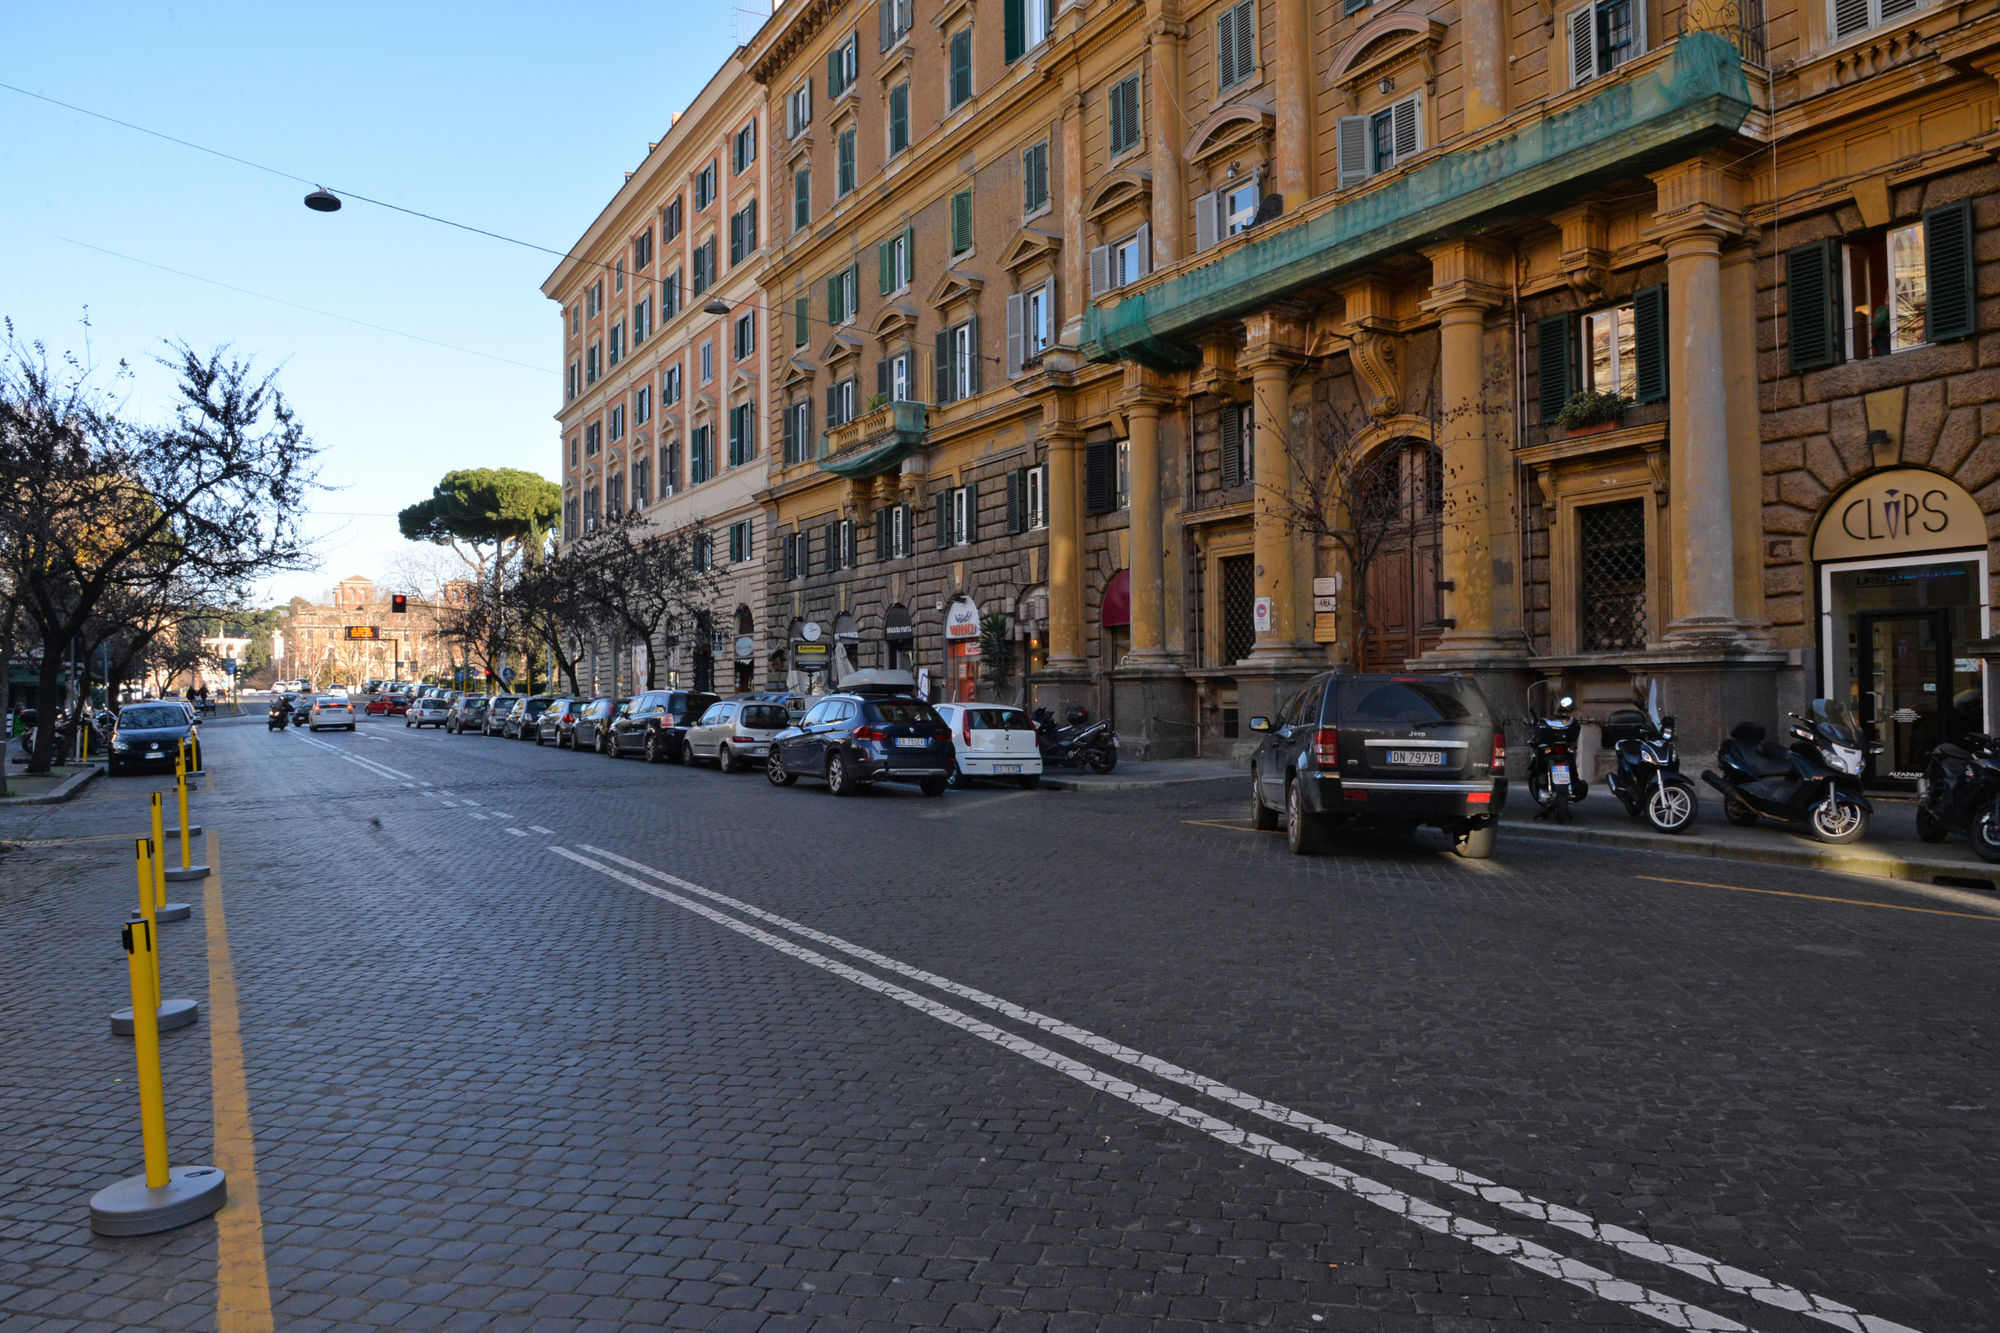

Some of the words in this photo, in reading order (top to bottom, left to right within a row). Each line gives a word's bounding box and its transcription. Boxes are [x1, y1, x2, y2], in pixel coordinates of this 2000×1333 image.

[1842, 489, 1949, 540] CLIPS
[950, 623, 975, 636] WIND
[1393, 751, 1406, 763] DN
[1408, 752, 1440, 763] 797YB
